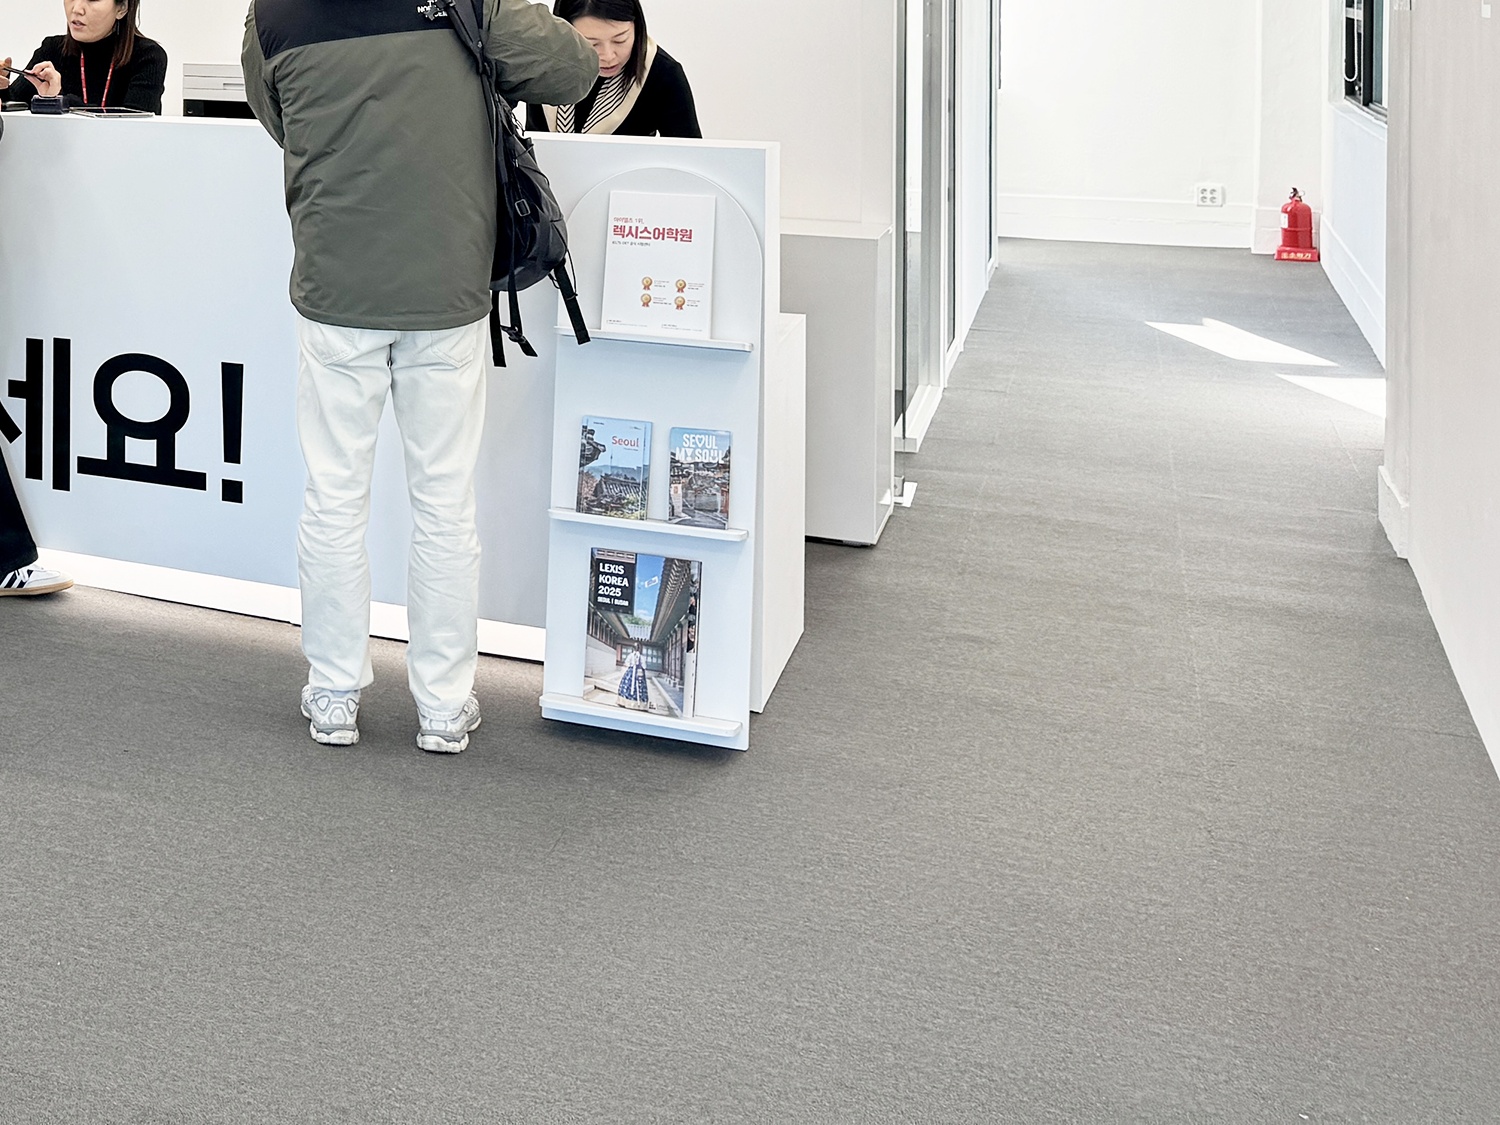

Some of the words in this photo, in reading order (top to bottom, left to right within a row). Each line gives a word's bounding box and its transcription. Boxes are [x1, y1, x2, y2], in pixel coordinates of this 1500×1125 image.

[612, 225, 693, 243] 렉시스어학원
[611, 435, 640, 448] Seoul
[599, 562, 625, 575] LEXIS
[598, 574, 629, 587] KOREA
[597, 585, 622, 597] 2025
